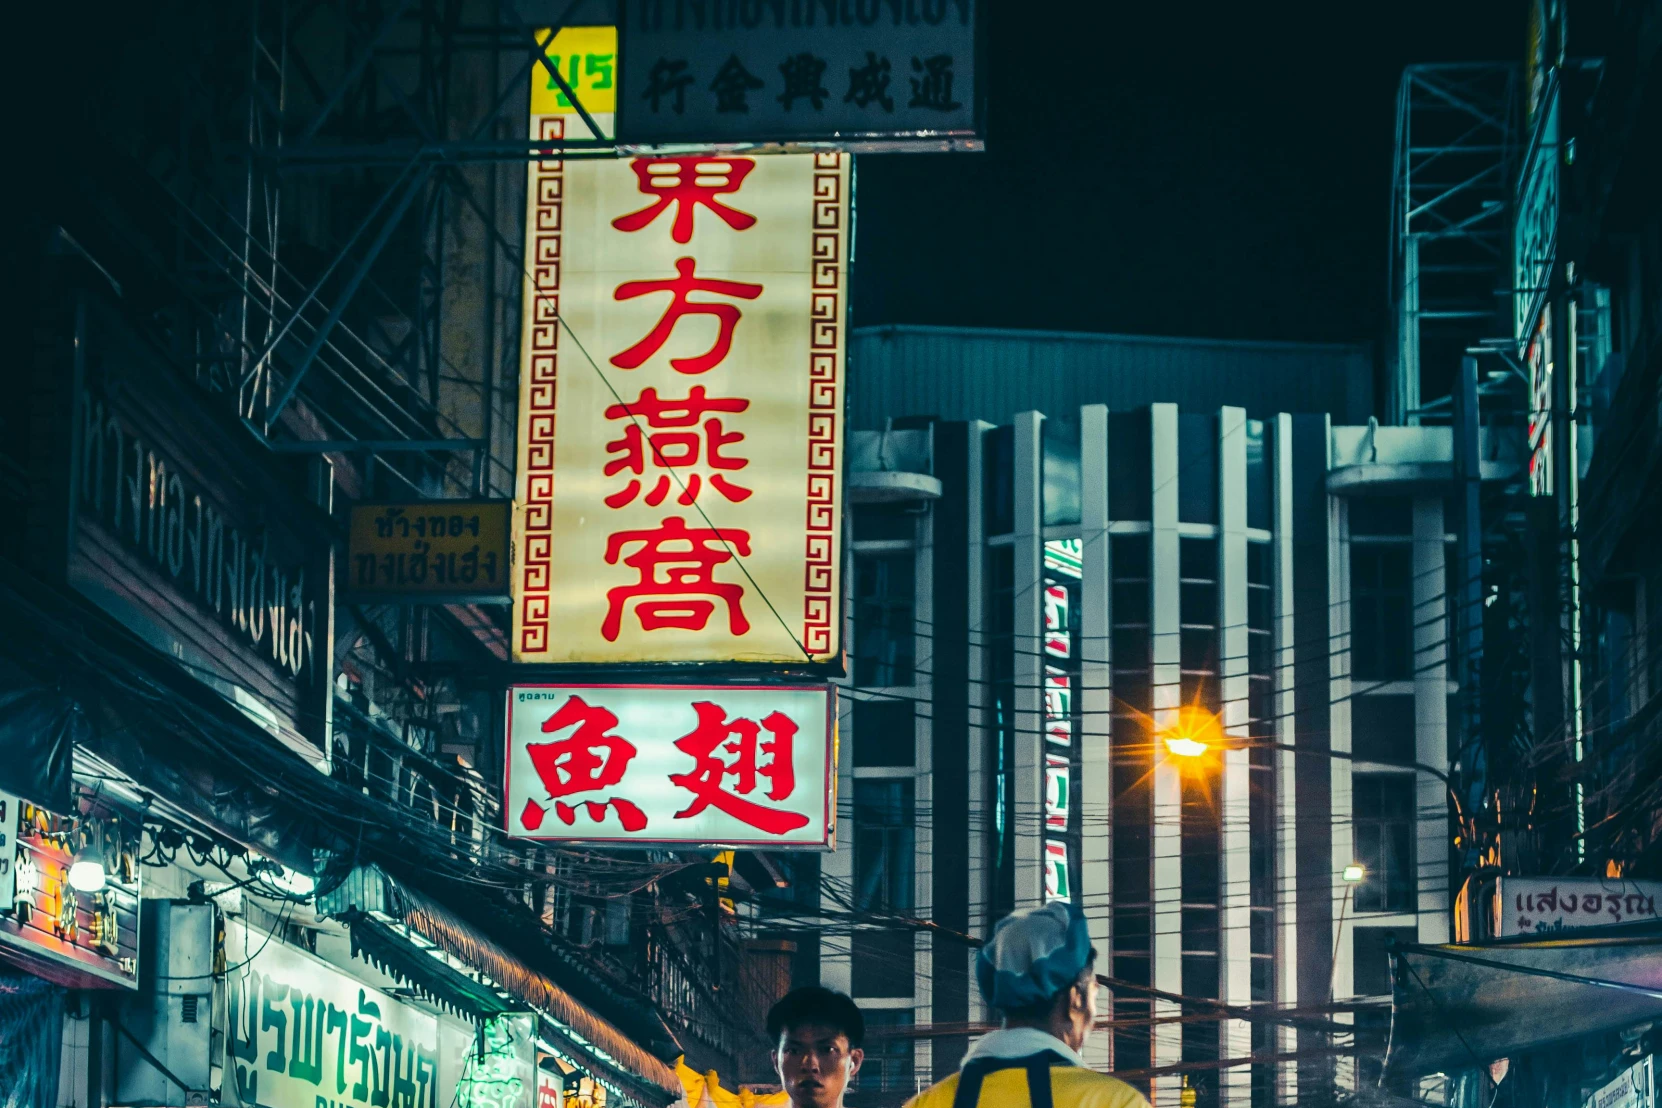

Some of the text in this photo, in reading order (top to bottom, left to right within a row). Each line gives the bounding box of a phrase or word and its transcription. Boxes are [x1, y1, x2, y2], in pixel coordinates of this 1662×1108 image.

[375, 508, 480, 538] ห้างทอง
[520, 694, 810, 835] 魚翅
[1516, 886, 1655, 922] แสงอรุณ
